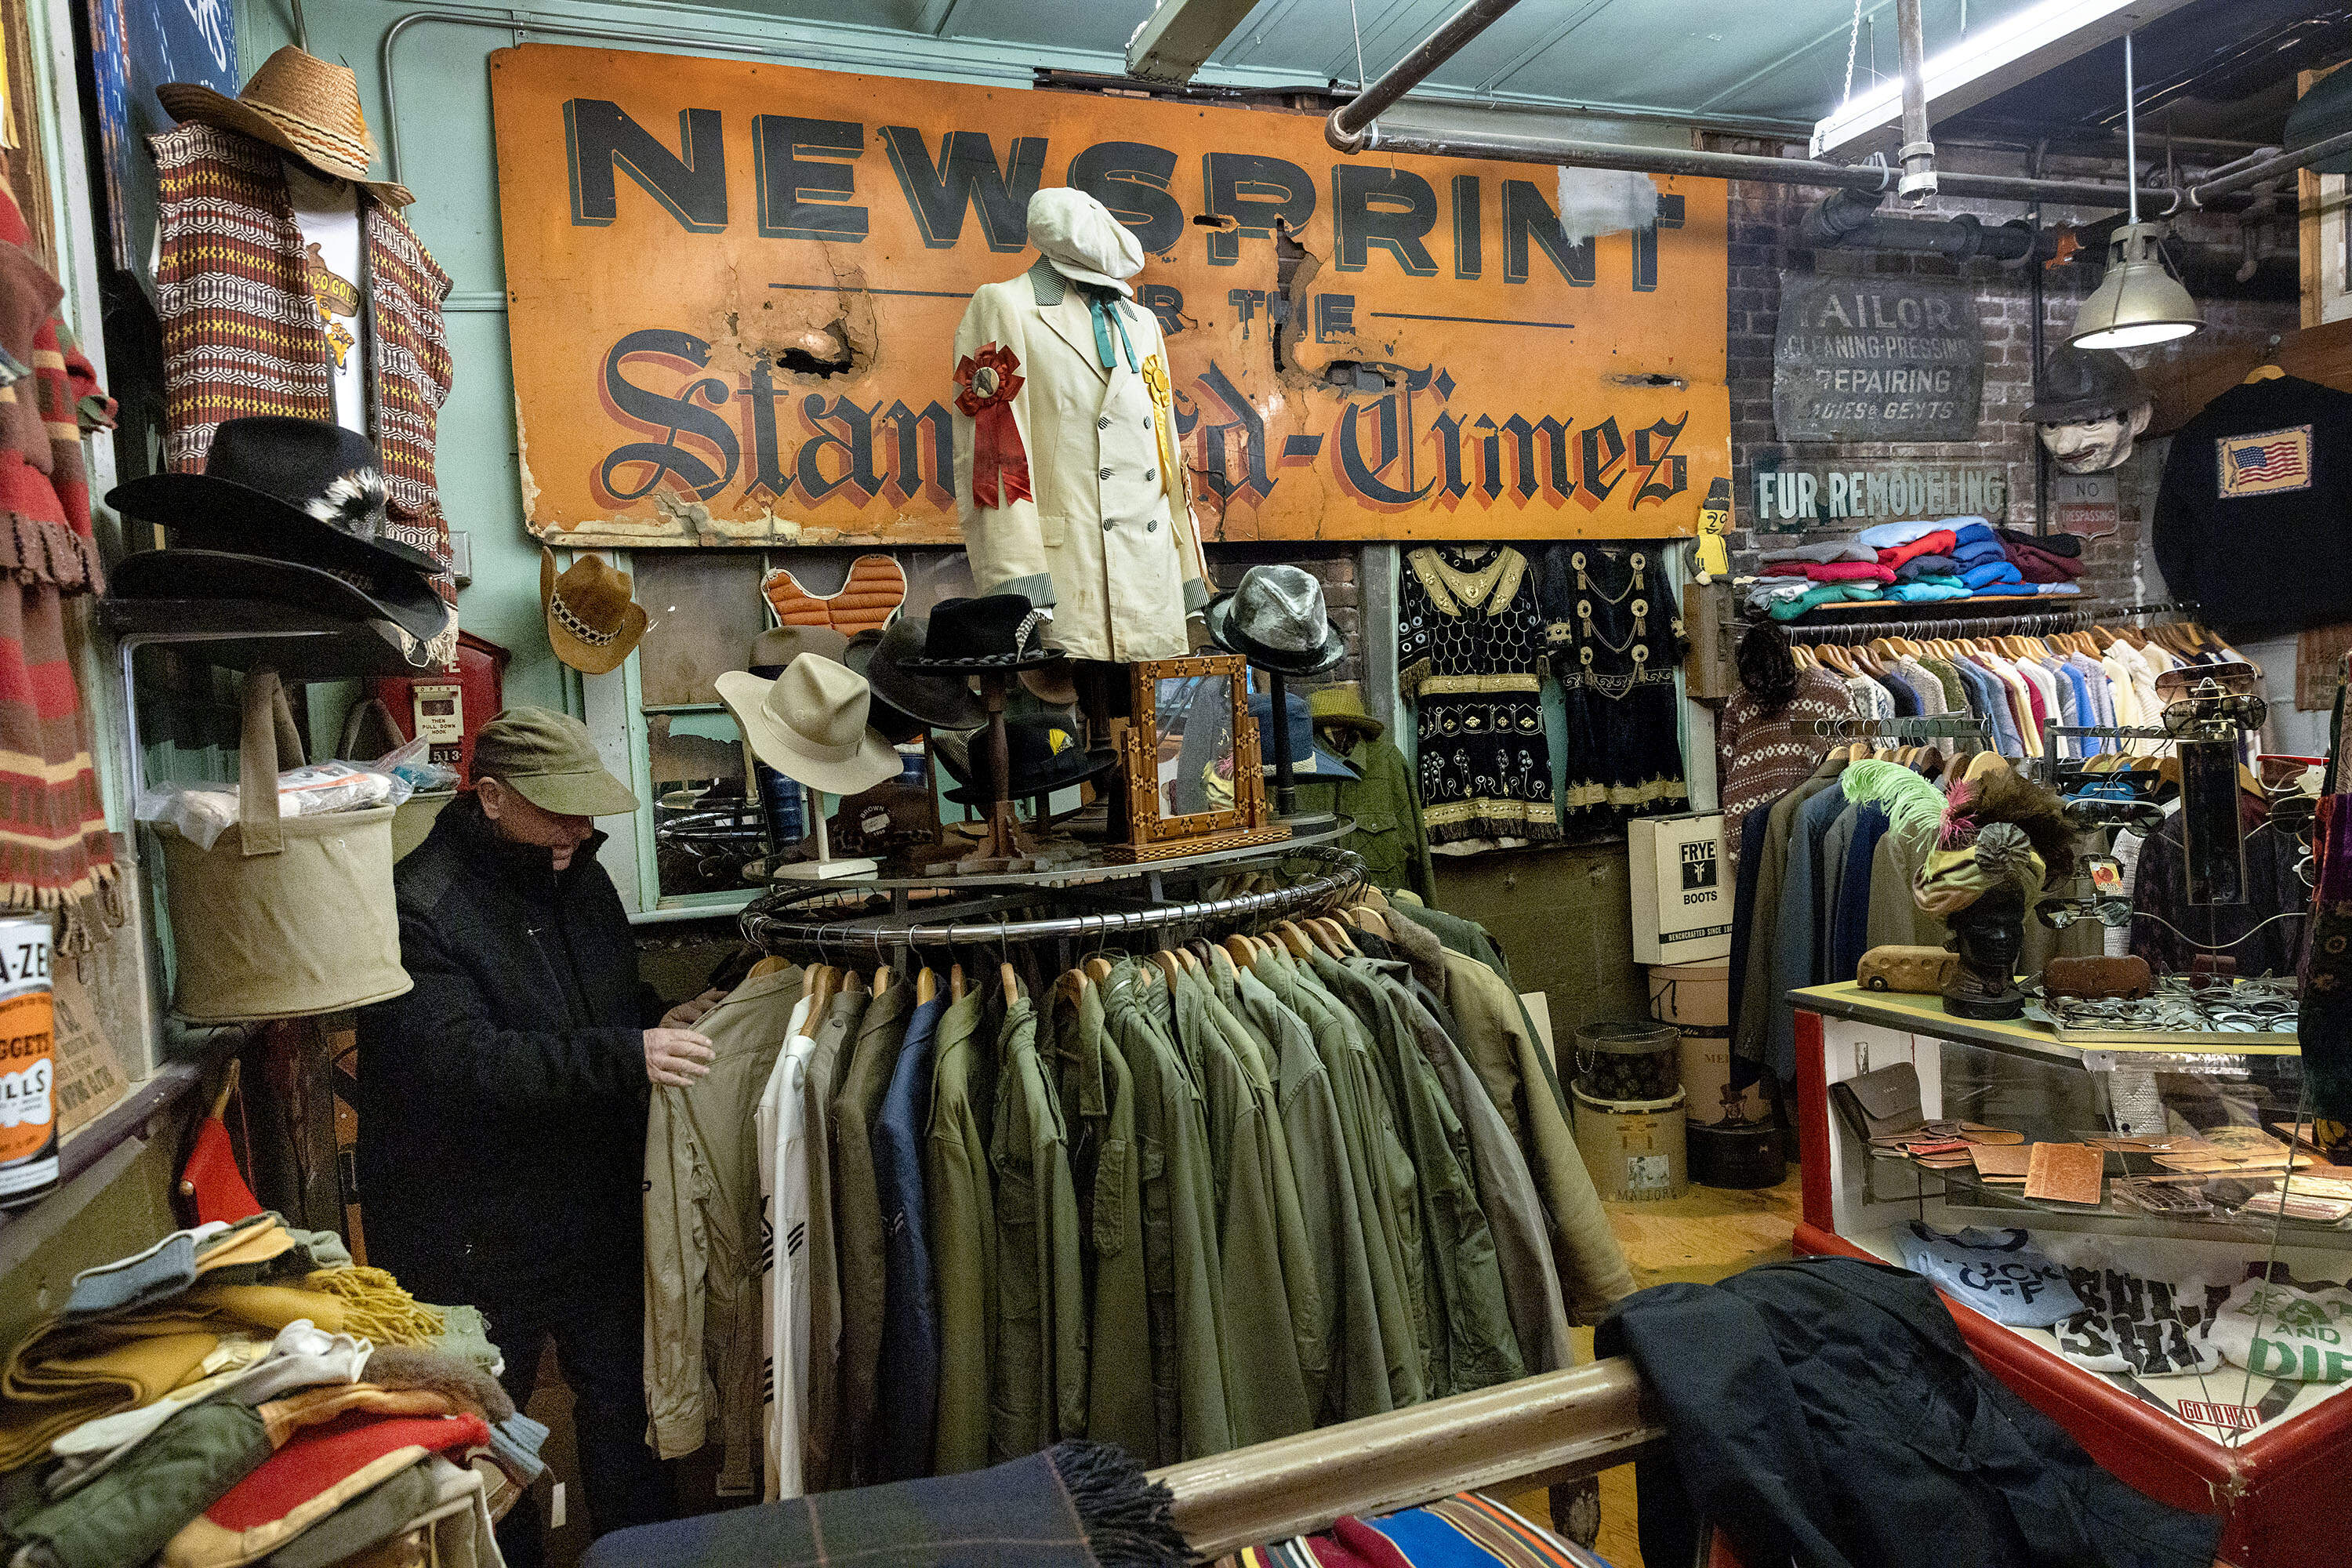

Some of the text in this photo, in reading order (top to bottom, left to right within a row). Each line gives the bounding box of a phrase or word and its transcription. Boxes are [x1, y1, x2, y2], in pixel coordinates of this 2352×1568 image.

[563, 97, 1686, 293] NEWSPRINT
[332, 279, 358, 306] GOLD
[1228, 289, 1356, 344] THE
[1800, 294, 1960, 329] AILOR
[1759, 471, 2000, 519] FUR REMODELING
[2061, 482, 2115, 522] NO TRESPASSING
[860, 805, 885, 818] BROWN
[1681, 841, 1715, 862] FRYE
[1683, 891, 1718, 905] BOOTS
[1668, 929, 1705, 942] BENCHCRAFTED
[1707, 926, 1722, 935] SINCE
[2274, 1322, 2342, 1345] AND
[2183, 1400, 2204, 1421] GO
[2202, 1403, 2225, 1424] TO
